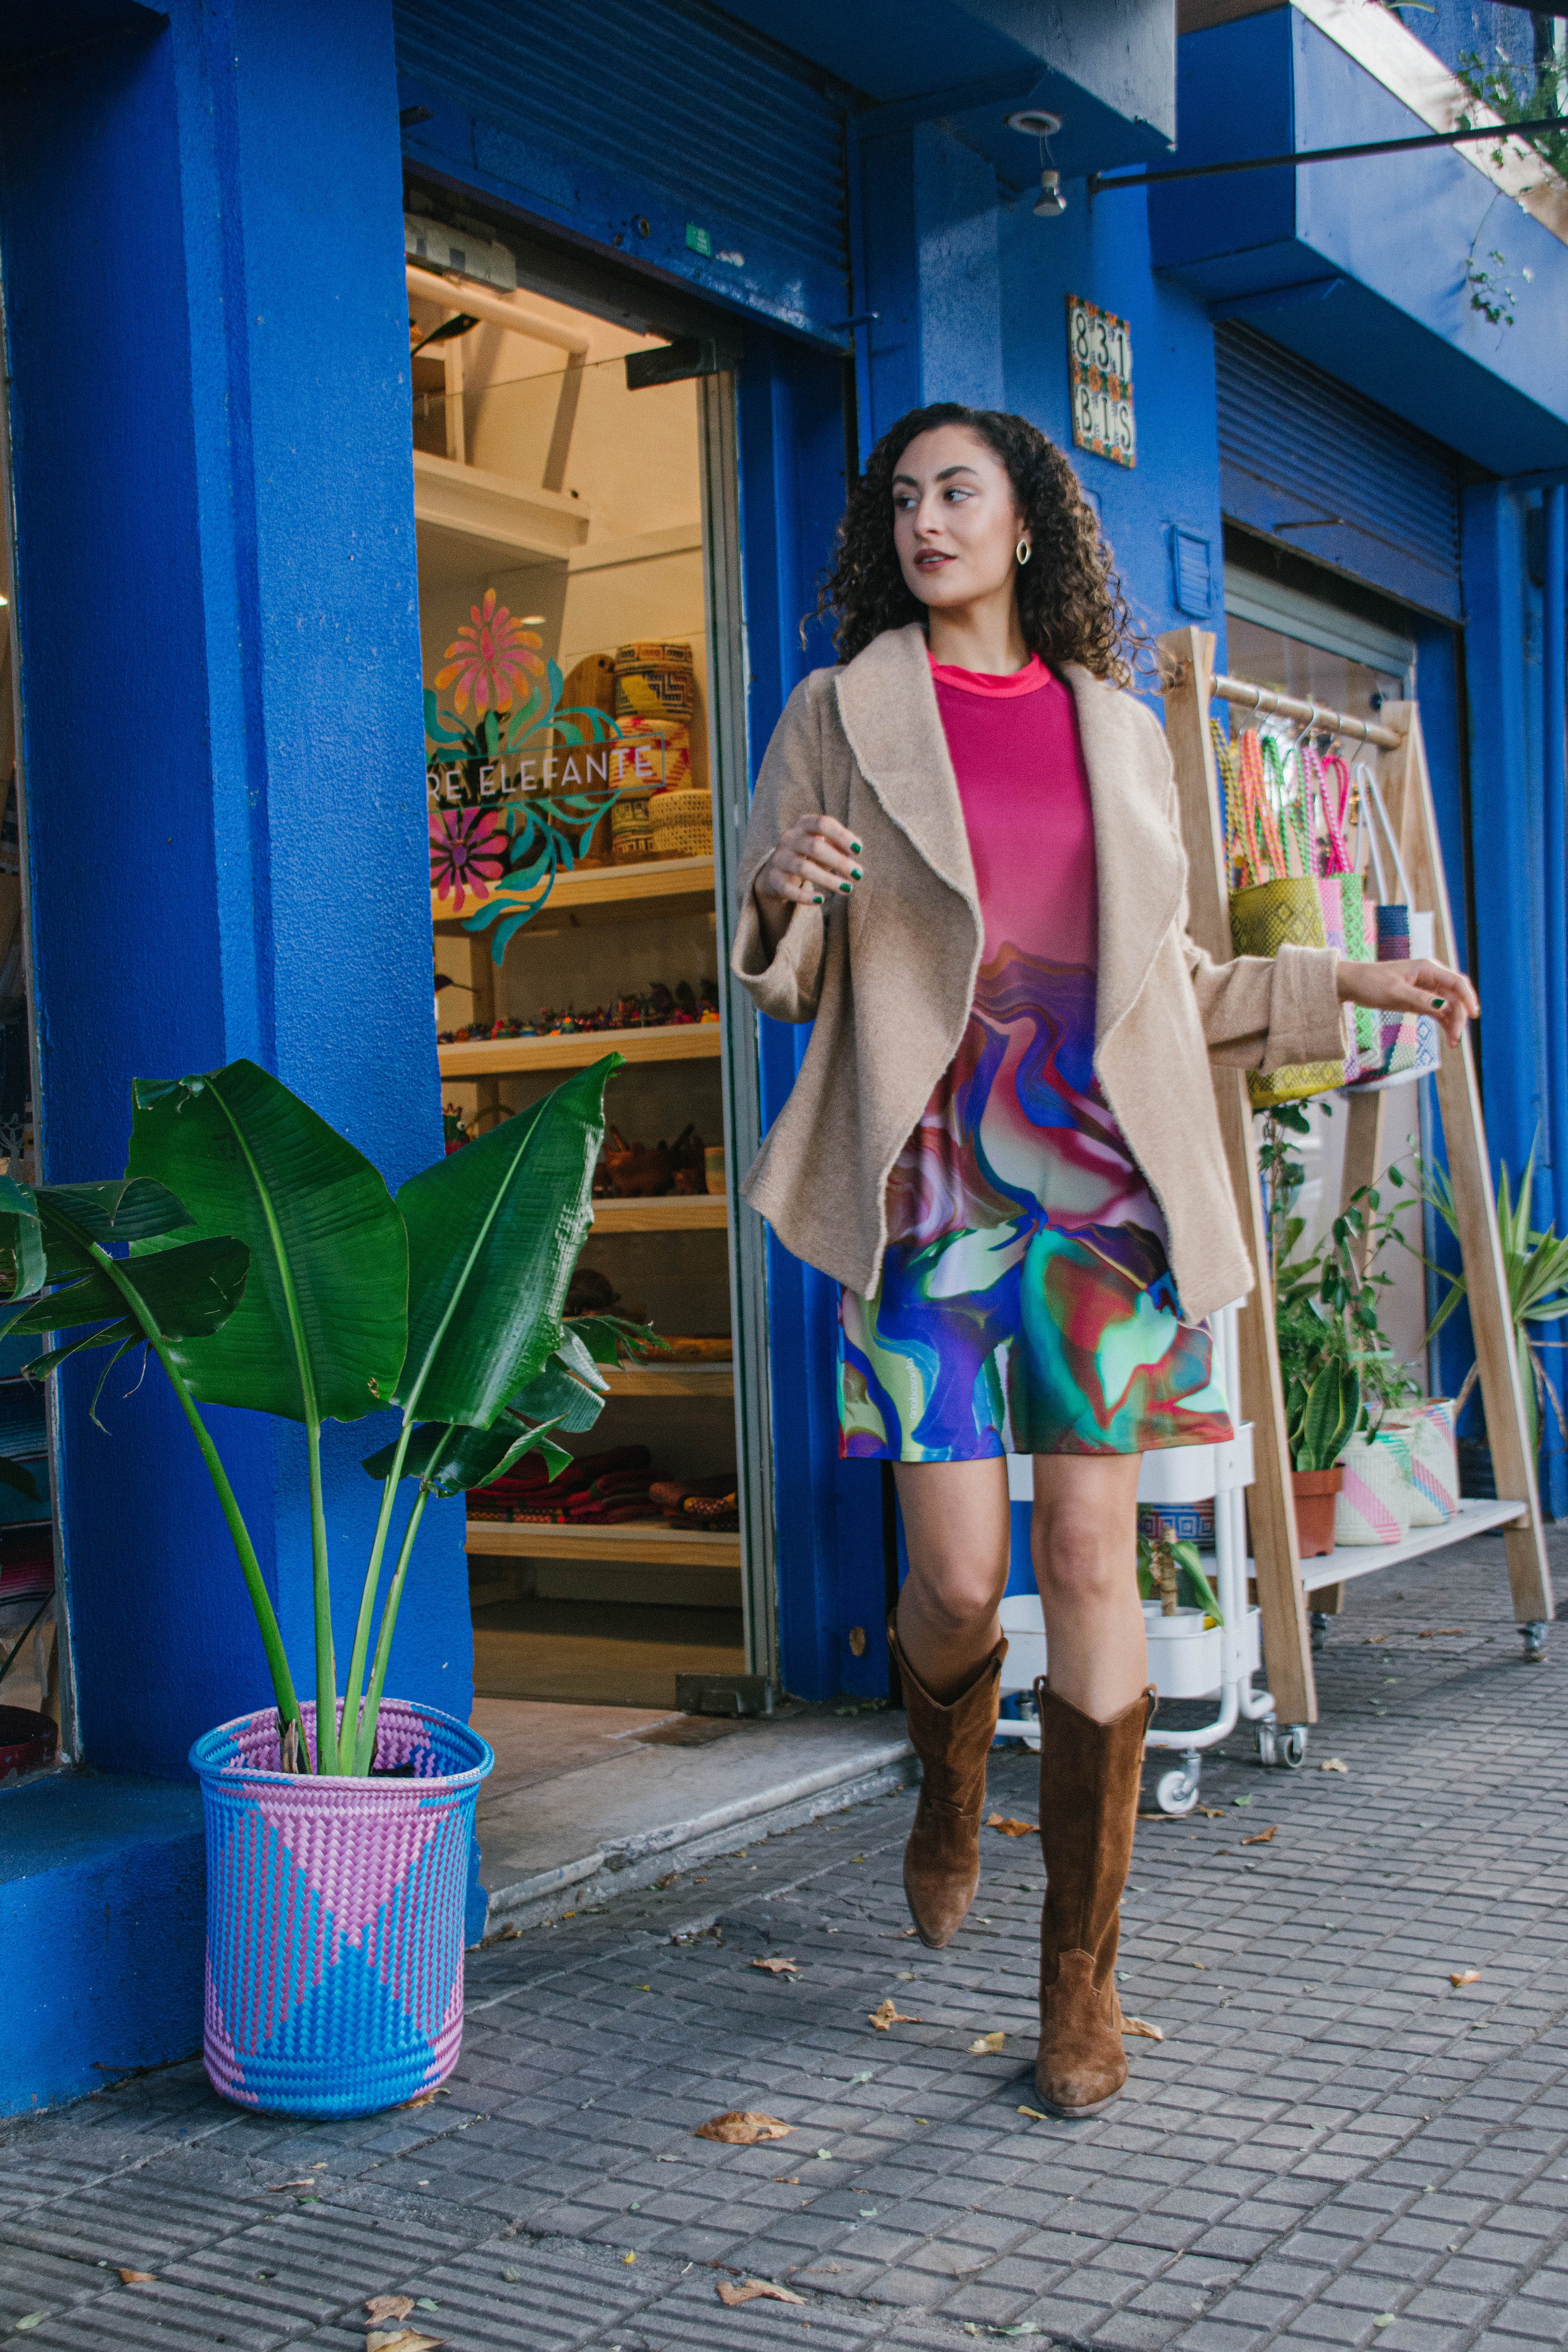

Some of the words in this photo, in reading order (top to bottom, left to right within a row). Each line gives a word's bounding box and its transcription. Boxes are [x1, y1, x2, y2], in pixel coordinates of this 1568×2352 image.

[1076, 312, 1125, 379] 831
[1080, 388, 1131, 450] BIS
[479, 746, 653, 796] ELEFANTE
